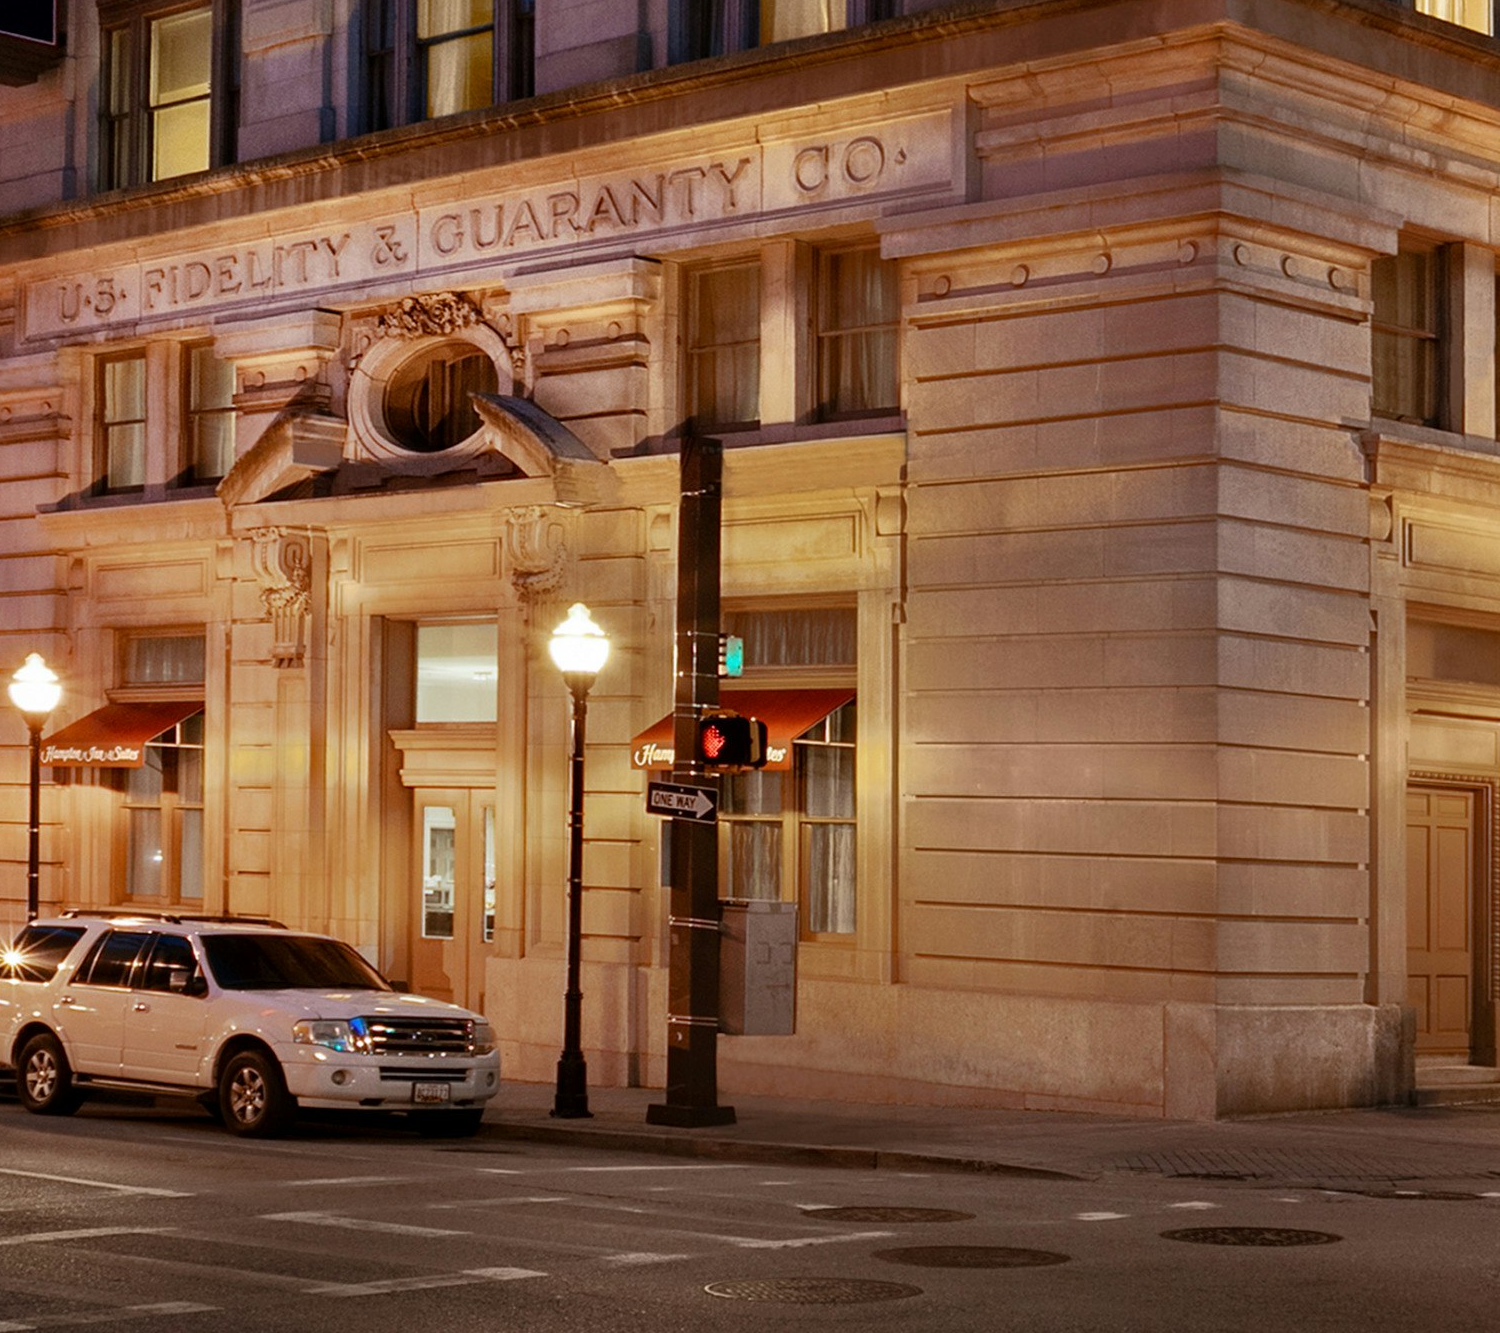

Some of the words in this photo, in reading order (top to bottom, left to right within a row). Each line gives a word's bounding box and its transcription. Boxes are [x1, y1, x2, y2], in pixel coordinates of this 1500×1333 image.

[144, 232, 352, 310] FIDELITY
[369, 224, 409, 269] &
[431, 155, 753, 255] GUARANTY
[653, 792, 674, 807] ONE
[676, 797, 697, 810] WAY
